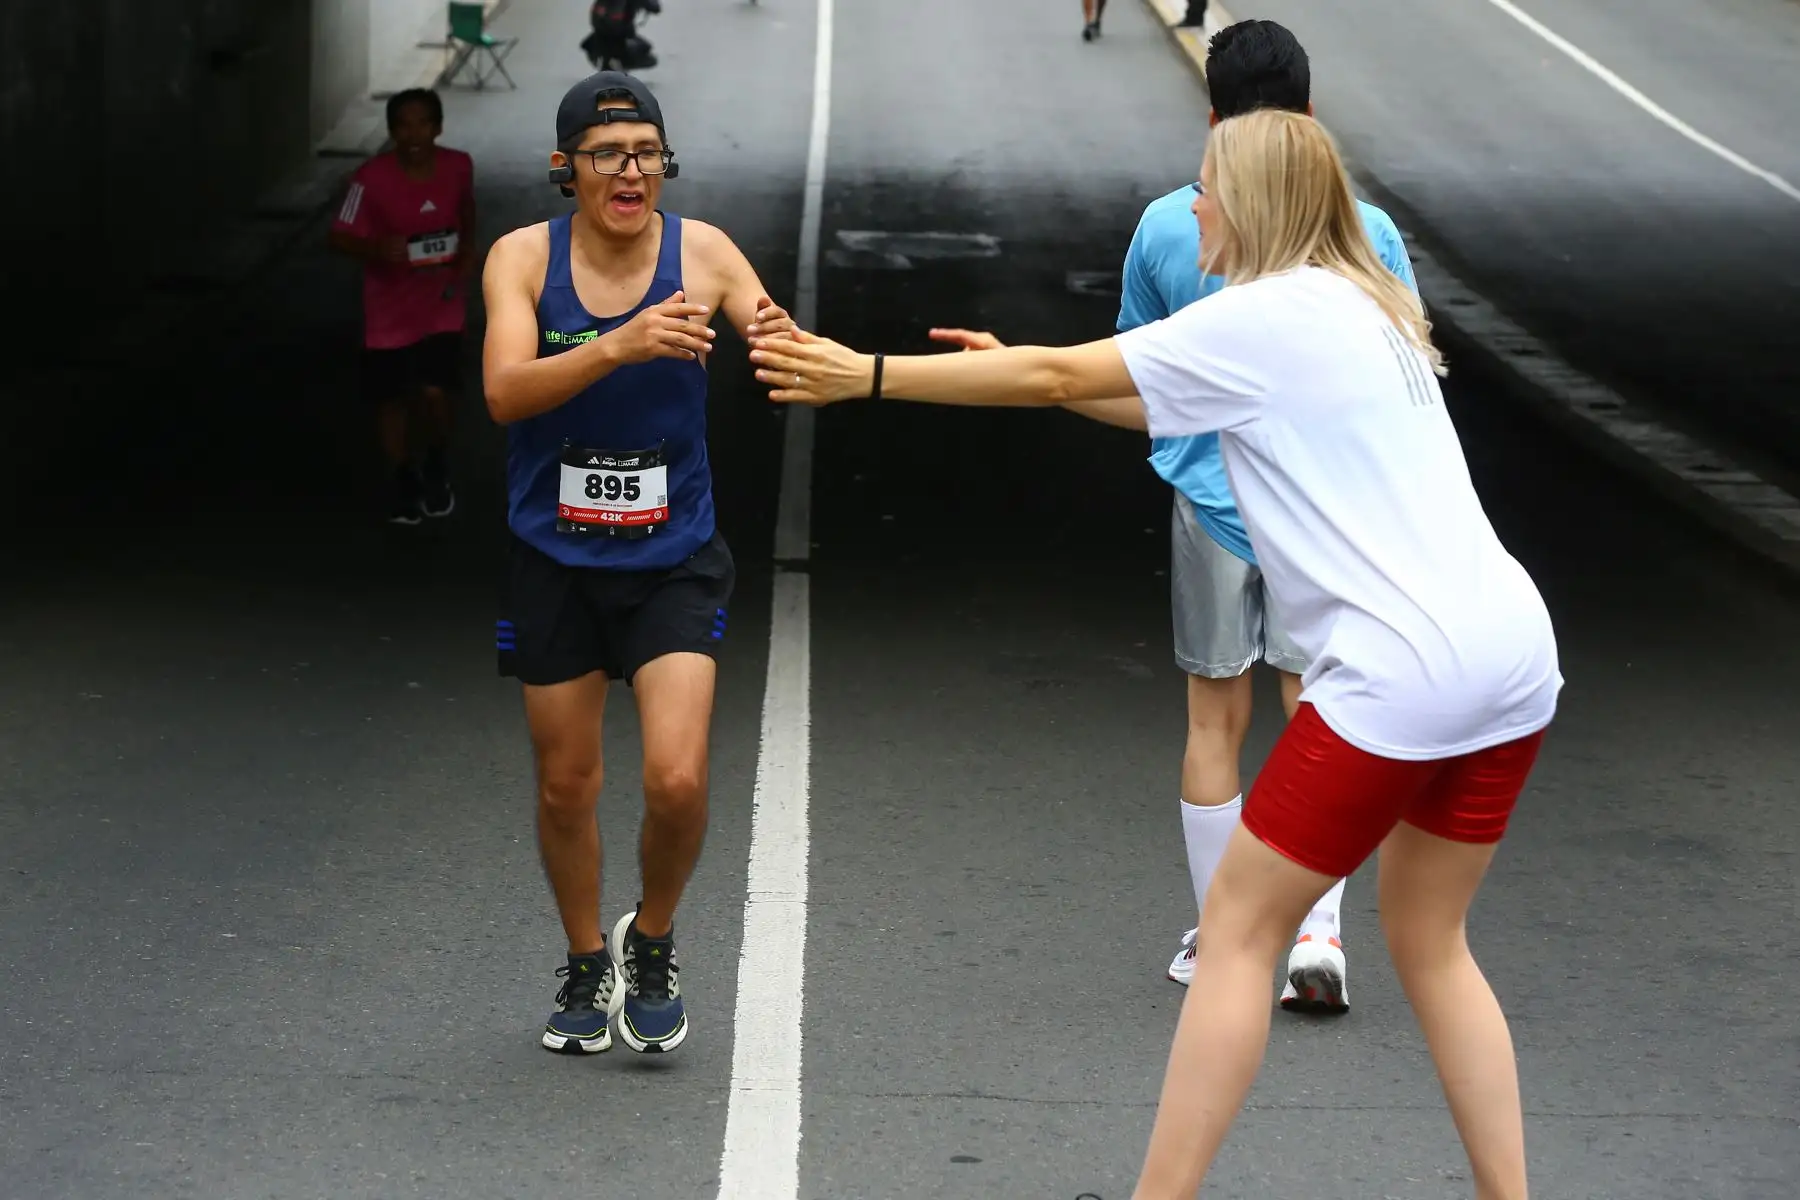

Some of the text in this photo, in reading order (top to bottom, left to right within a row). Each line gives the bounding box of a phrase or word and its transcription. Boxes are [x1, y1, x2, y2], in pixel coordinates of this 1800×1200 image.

[545, 330, 561, 340] life
[585, 473, 640, 501] 895
[600, 512, 623, 522] 42K
